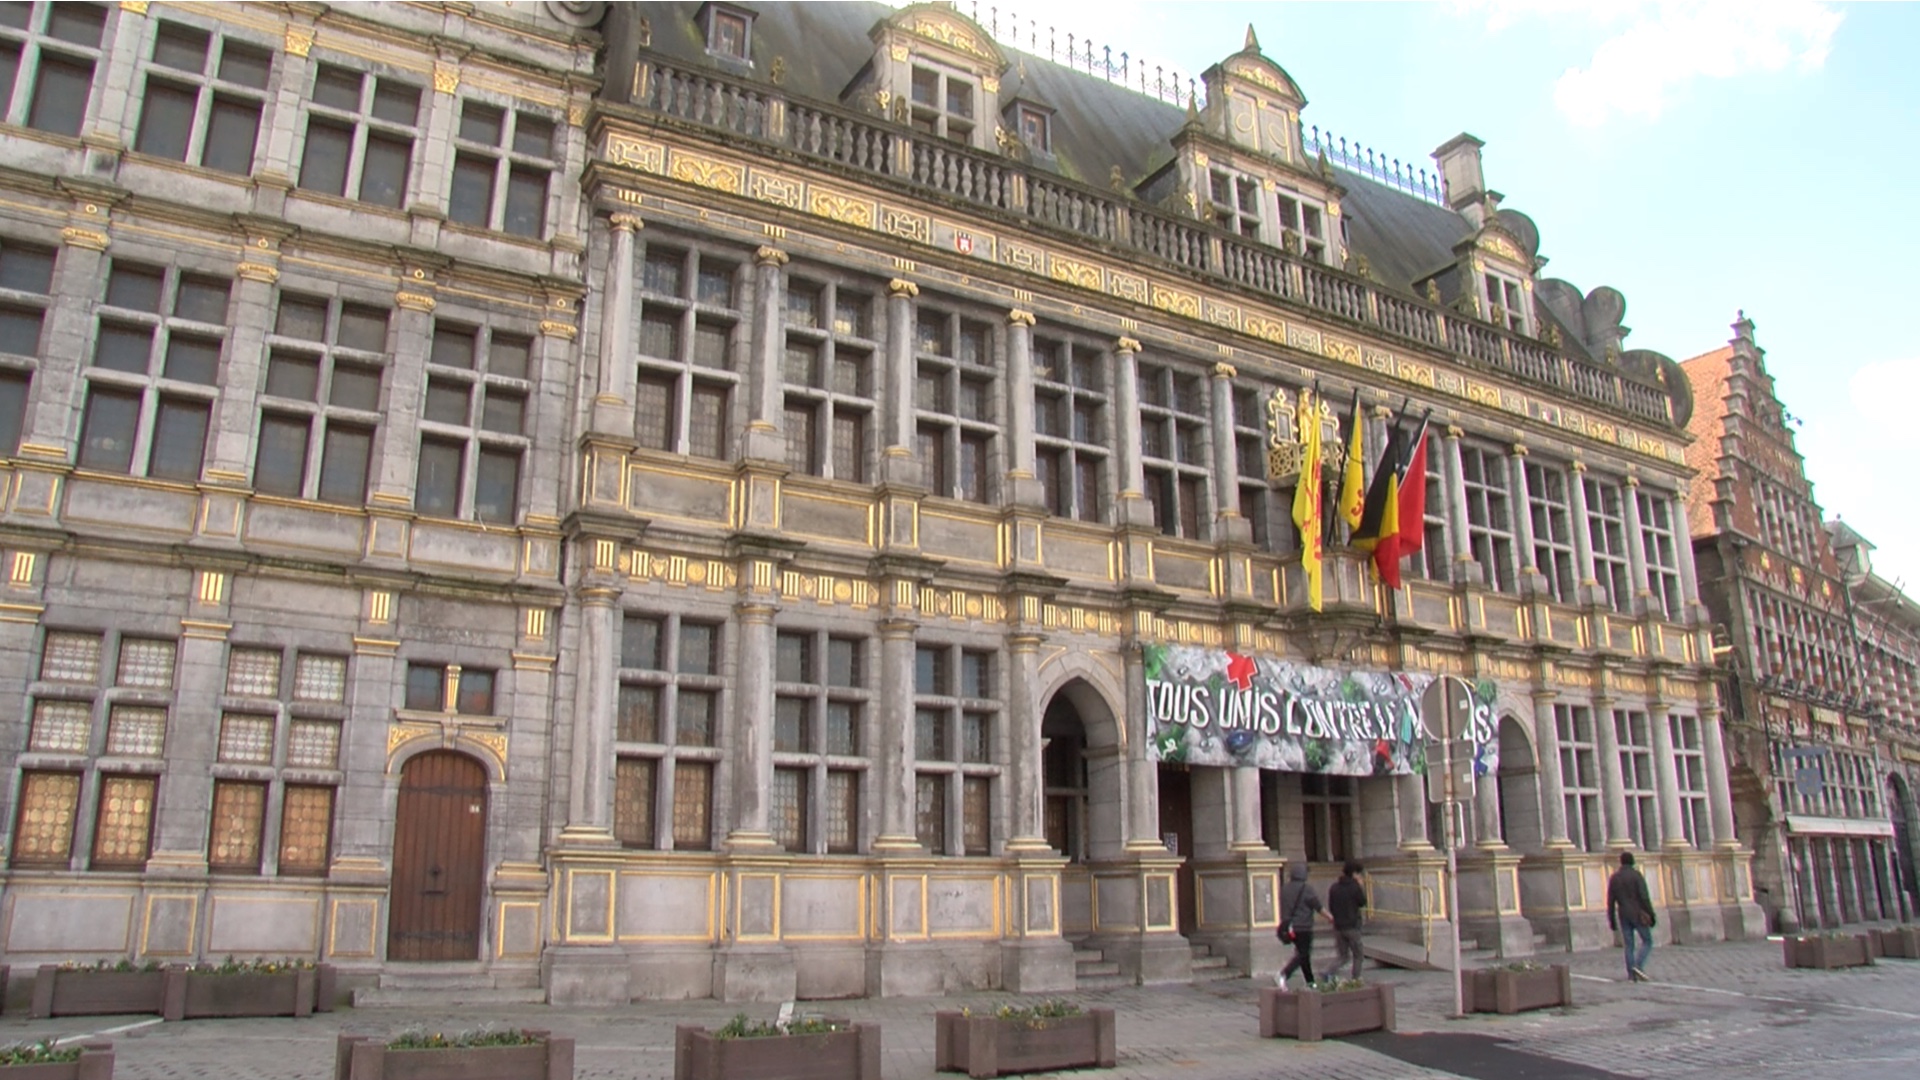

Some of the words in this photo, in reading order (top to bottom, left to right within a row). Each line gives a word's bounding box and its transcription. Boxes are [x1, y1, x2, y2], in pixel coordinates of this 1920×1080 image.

[1146, 679, 1209, 728] TOUS
[1219, 685, 1280, 735] UNIS
[1286, 694, 1378, 740] CONTRE
